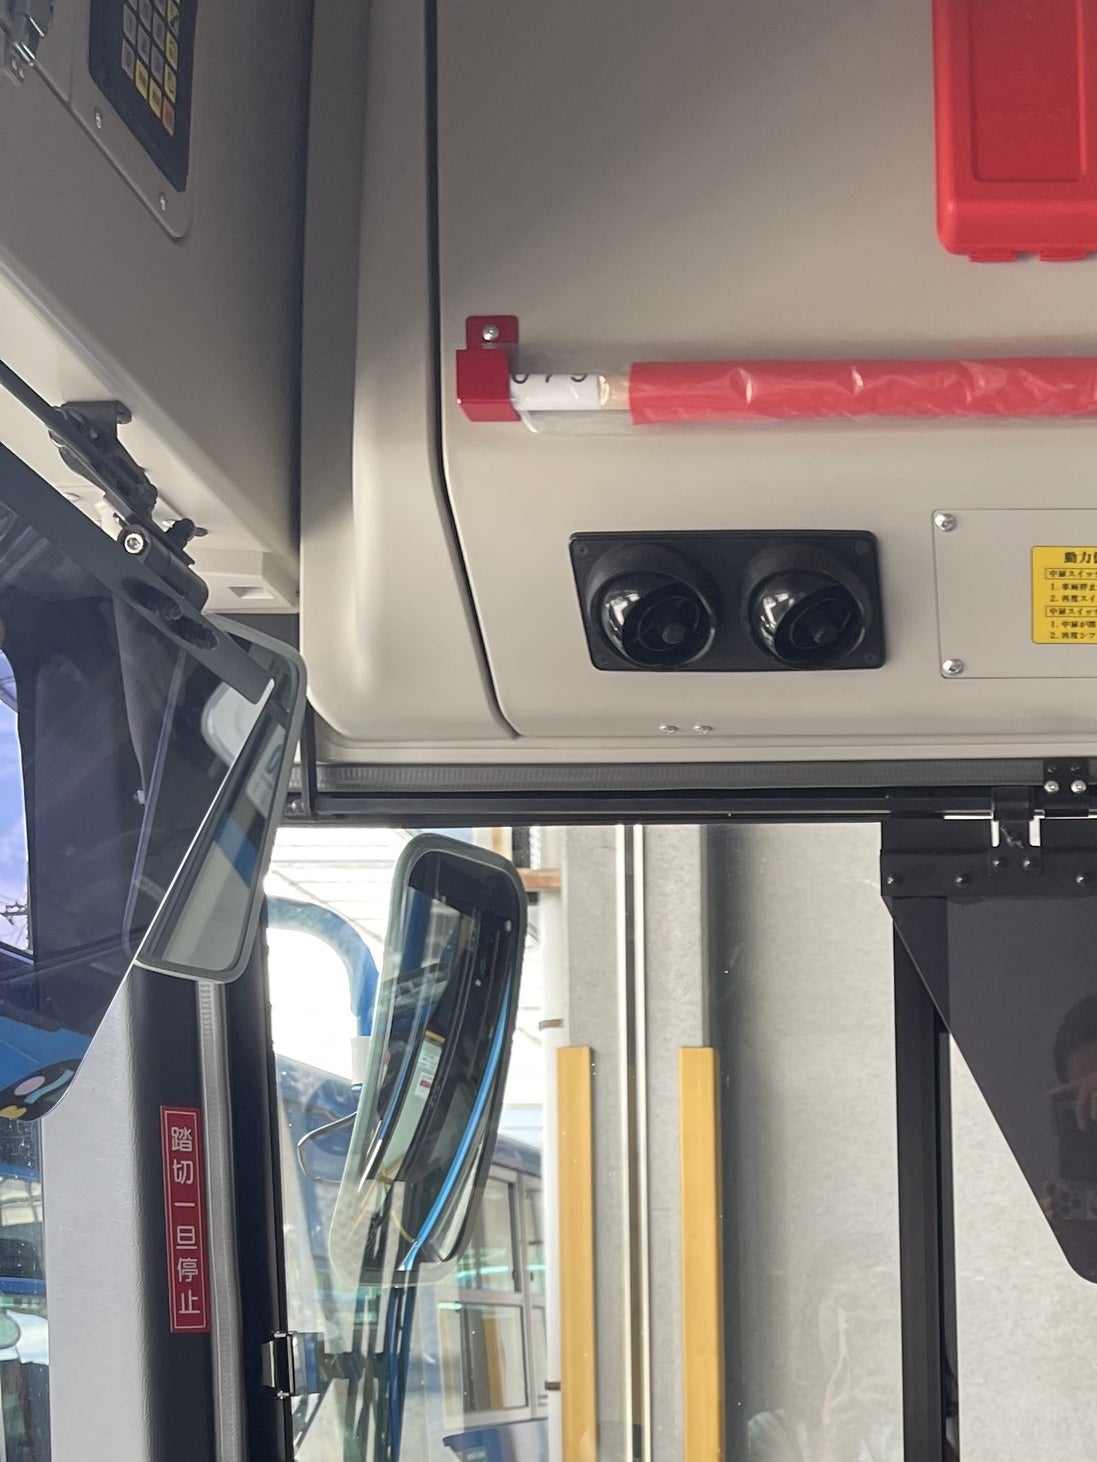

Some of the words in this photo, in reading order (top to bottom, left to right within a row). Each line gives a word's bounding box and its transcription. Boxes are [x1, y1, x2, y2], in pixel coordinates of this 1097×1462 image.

[171, 1126, 201, 1314] 踏切一旦停止
